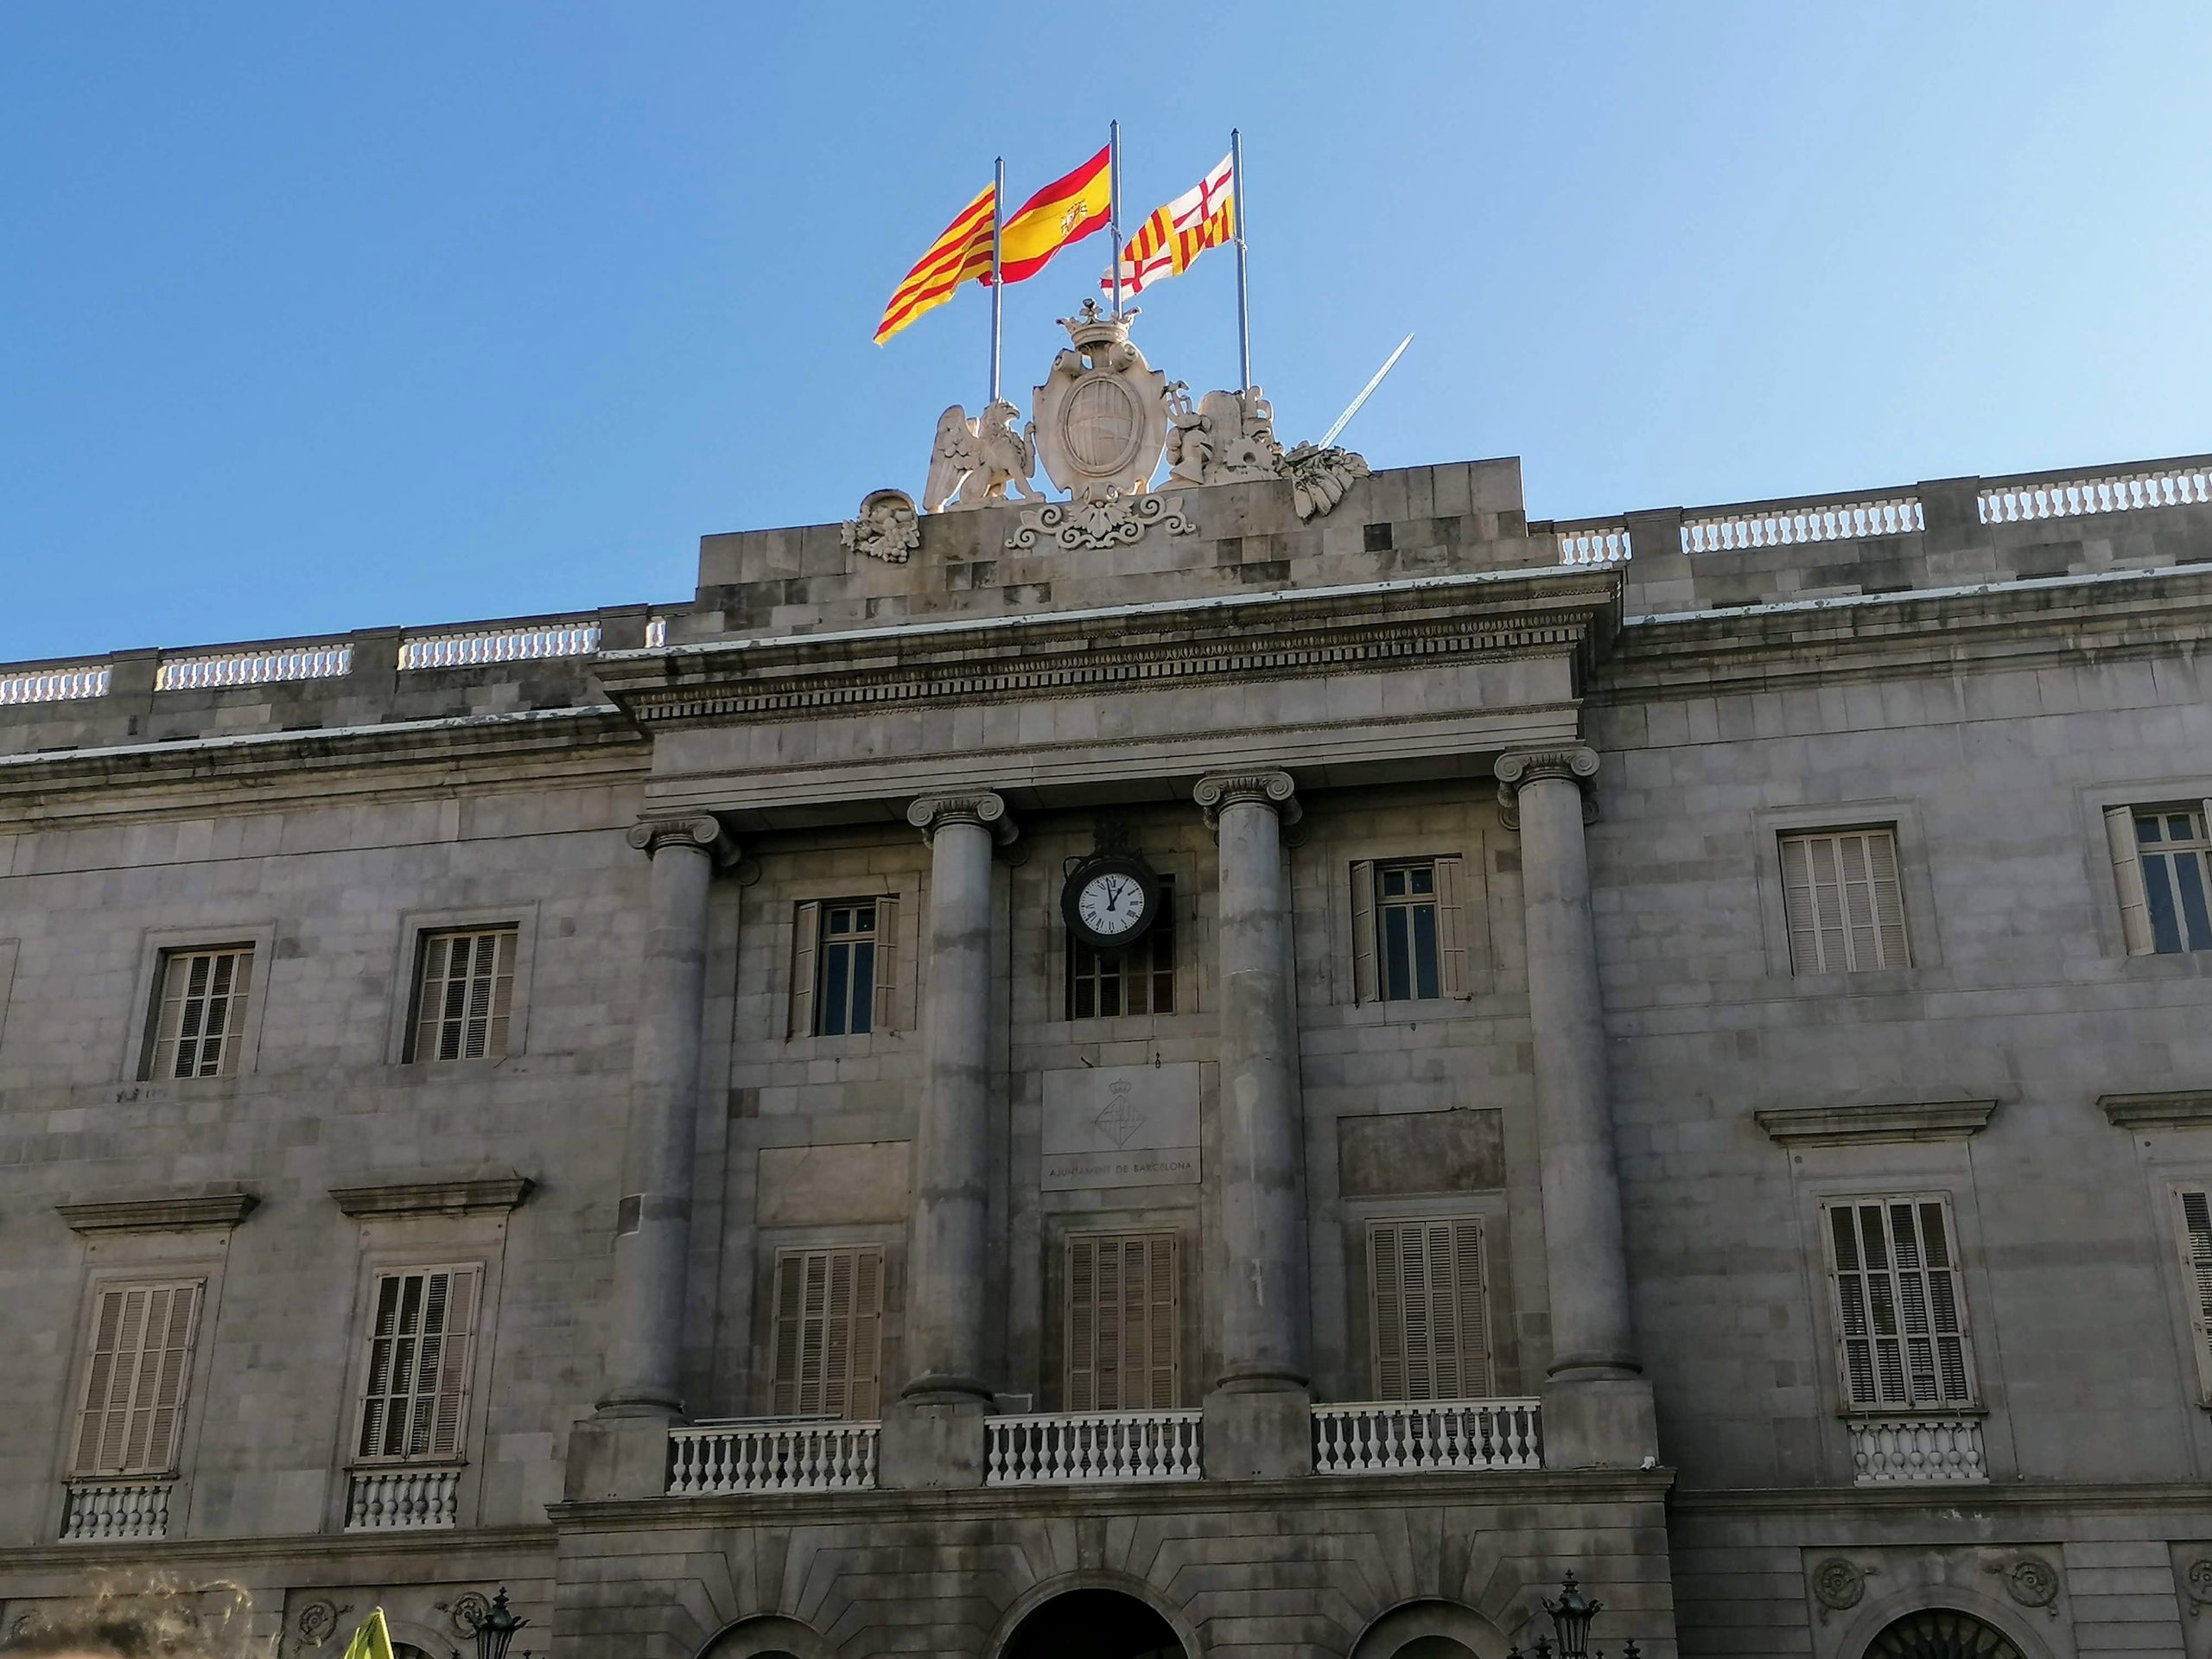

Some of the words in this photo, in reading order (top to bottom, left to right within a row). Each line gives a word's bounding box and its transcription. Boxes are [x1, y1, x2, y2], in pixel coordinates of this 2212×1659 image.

[1050, 1166, 1110, 1177] AJUNTAMENT
[1116, 1165, 1128, 1173] DE
[1134, 1161, 1192, 1173] BARCELONA
